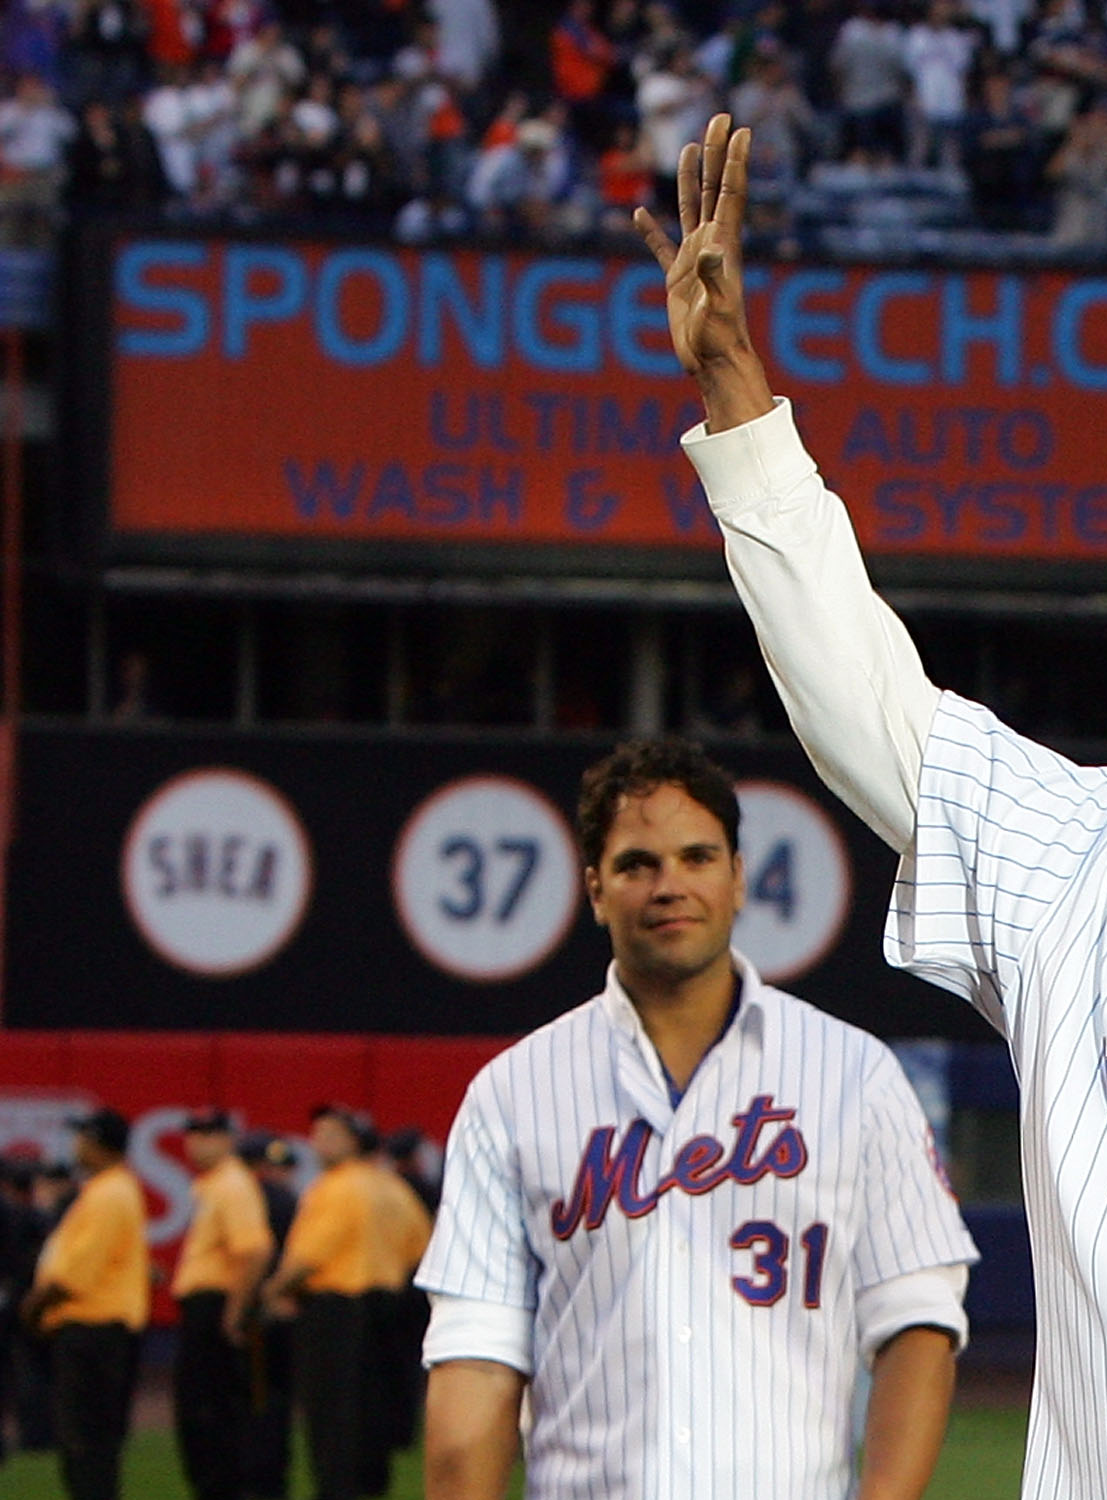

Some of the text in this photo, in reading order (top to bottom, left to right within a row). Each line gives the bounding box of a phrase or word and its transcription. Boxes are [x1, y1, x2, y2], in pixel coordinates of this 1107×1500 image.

[841, 406, 1055, 472] AUTO
[285, 458, 522, 528] WASH
[147, 834, 277, 900] SHEA
[437, 836, 543, 924] 37
[750, 836, 798, 926] 4
[550, 1095, 808, 1241] Mets
[729, 1220, 828, 1309] 31
